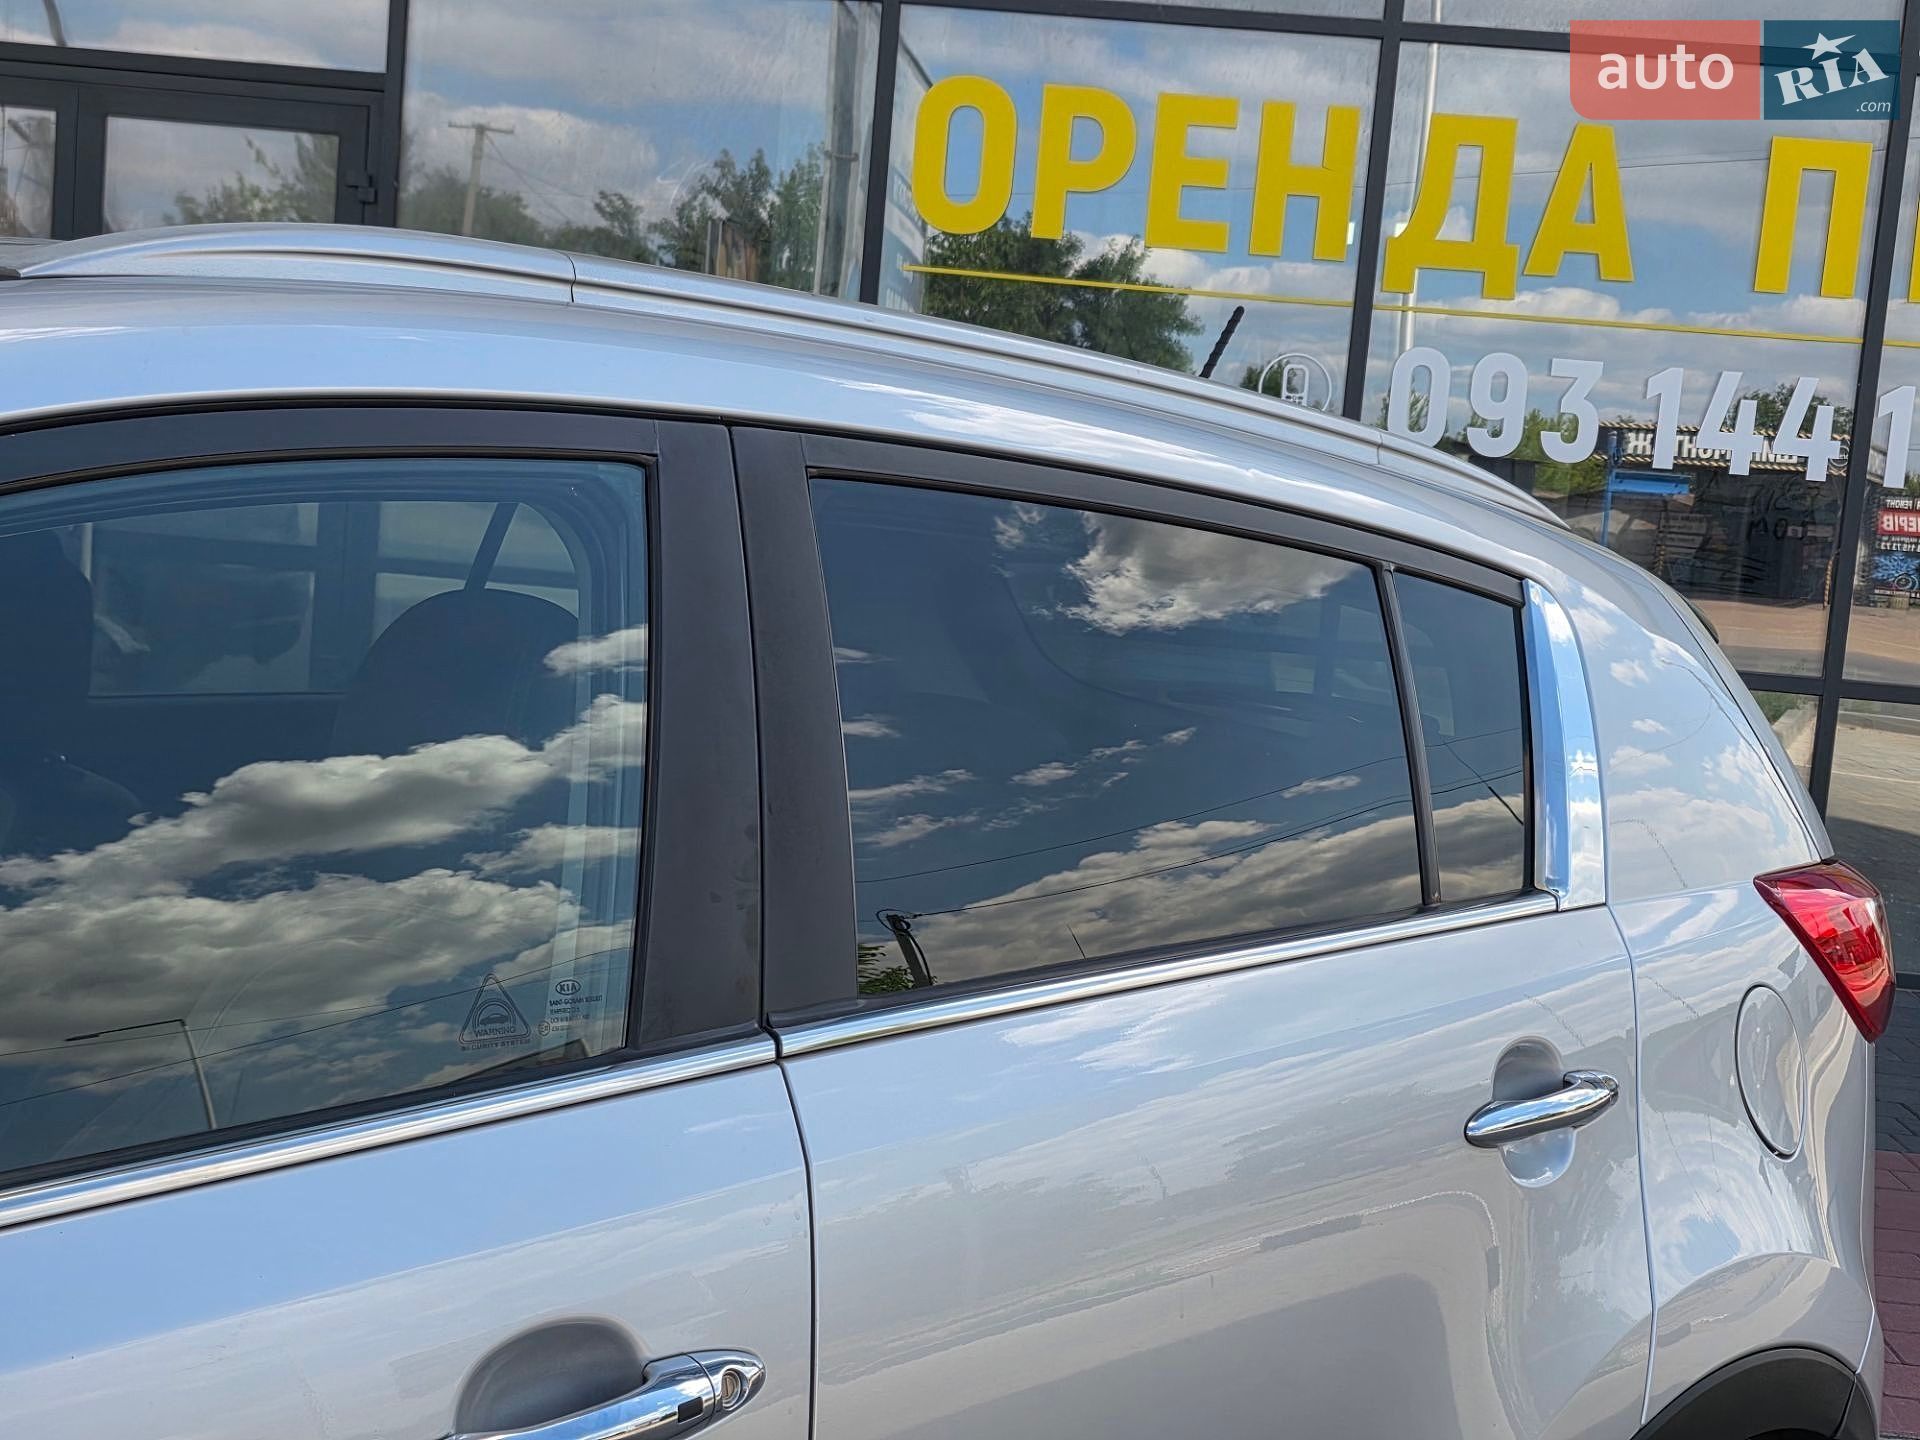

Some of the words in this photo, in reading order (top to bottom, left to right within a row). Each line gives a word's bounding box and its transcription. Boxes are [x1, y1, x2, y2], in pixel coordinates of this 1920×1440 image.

[912, 75, 1634, 301] ОРЕНДА
[1753, 136, 1920, 304] П
[1387, 346, 1604, 464] 093
[558, 981, 579, 994] KIA
[474, 1026, 516, 1037] WARNING
